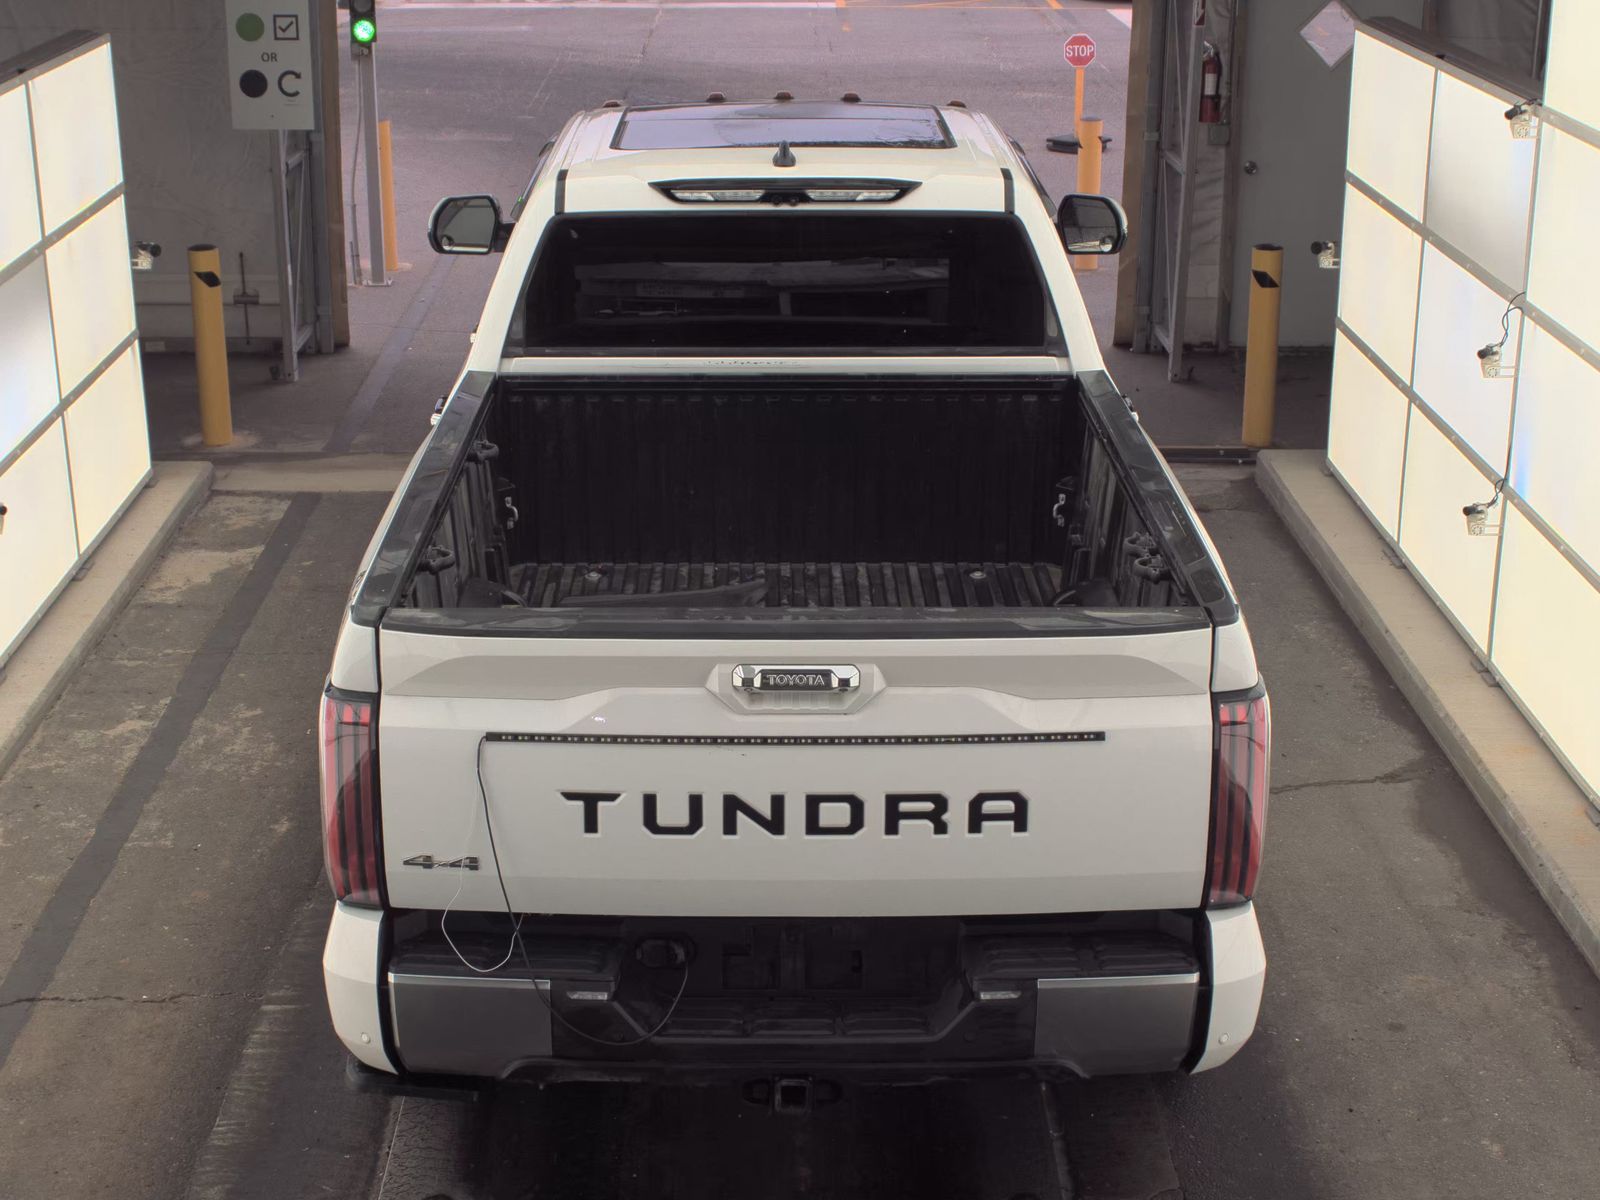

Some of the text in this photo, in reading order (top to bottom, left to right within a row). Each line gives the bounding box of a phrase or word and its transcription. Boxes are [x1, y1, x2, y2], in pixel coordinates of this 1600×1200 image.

[261, 52, 278, 62] OR
[1066, 45, 1094, 57] STOP
[766, 674, 825, 687] TOYOTA
[559, 791, 1030, 837] TUNDRA
